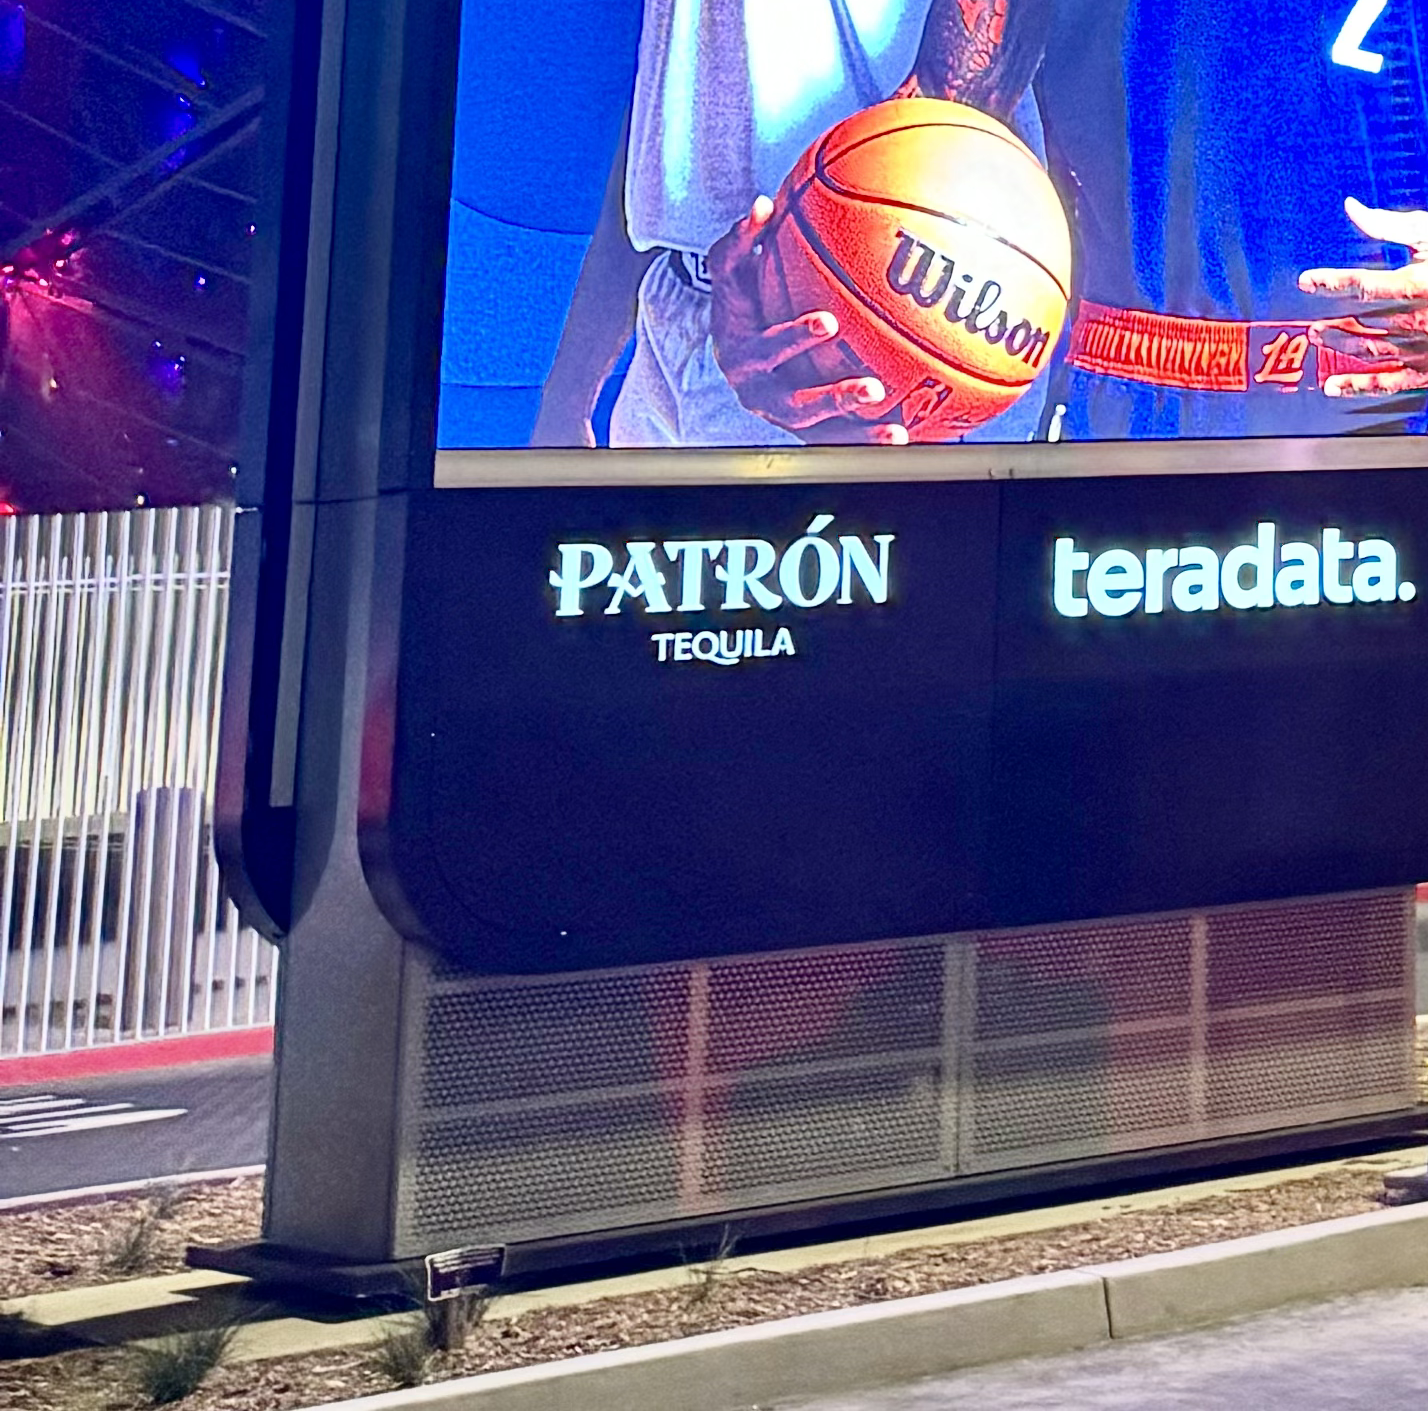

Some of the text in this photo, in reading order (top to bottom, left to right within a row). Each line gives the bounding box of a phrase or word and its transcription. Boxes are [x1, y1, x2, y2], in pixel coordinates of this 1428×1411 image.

[885, 227, 1051, 369] Wilson
[1253, 330, 1310, 384] LA
[548, 513, 896, 617] PATRÓN
[1052, 520, 1418, 619] teradata.
[650, 626, 797, 666] TEQUILA
